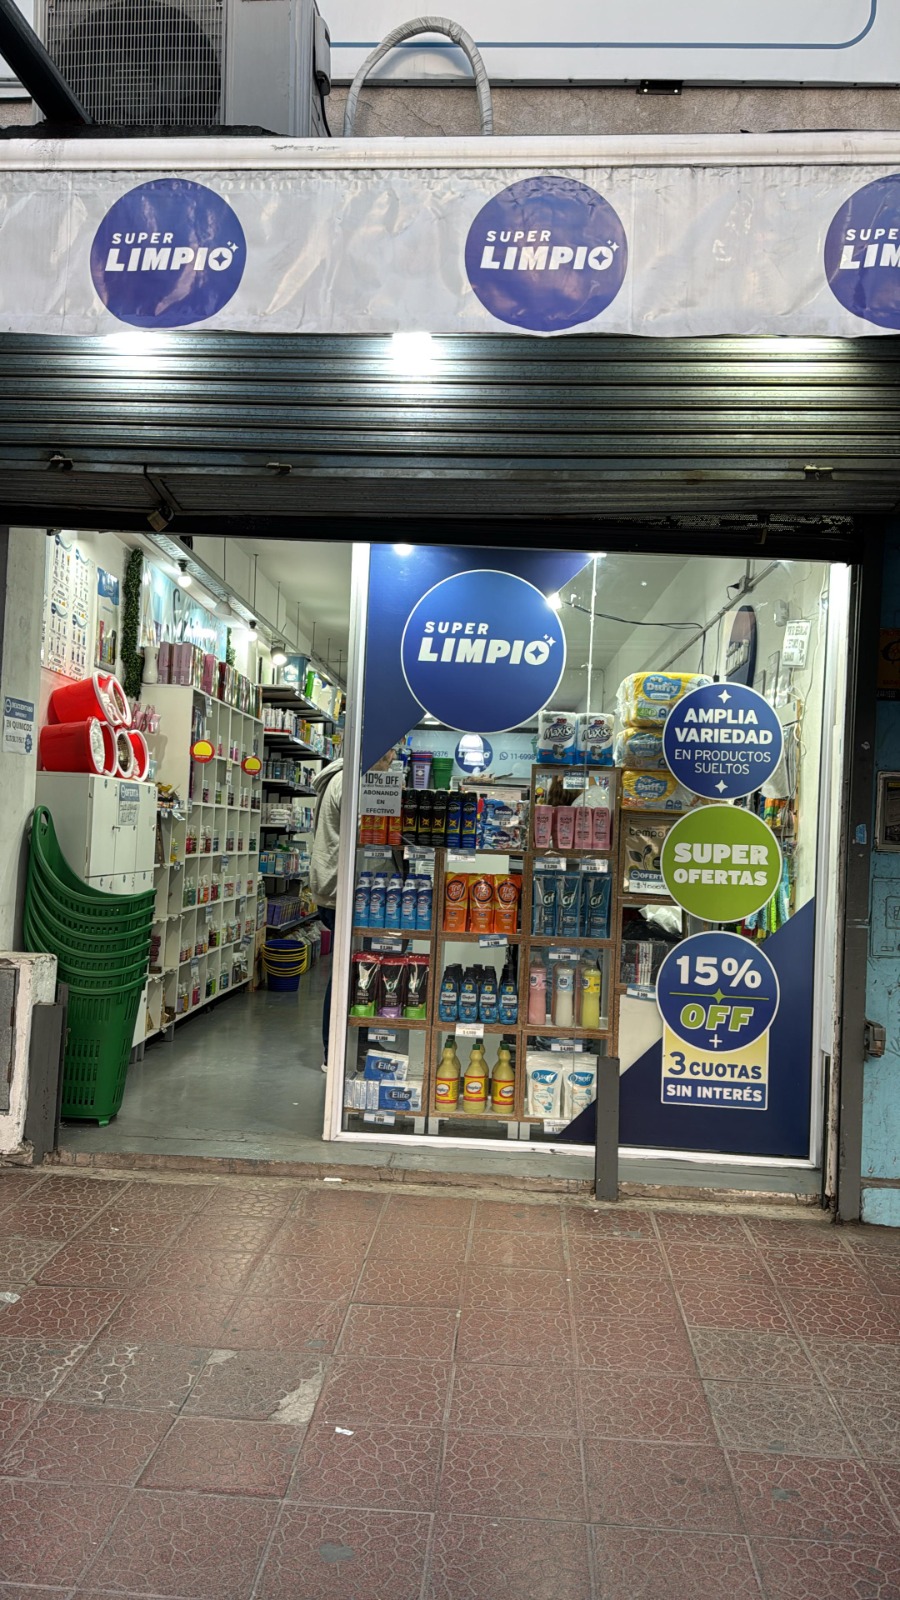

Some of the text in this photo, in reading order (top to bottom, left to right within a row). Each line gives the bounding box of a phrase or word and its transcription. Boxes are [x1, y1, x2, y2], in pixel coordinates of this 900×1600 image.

[112, 232, 174, 244] SUPER
[486, 230, 551, 243] SUPER
[845, 228, 899, 241] SUPE
[105, 247, 233, 272] LIMPIO
[480, 245, 614, 271] LIMPIO
[424, 621, 489, 635] SUPER
[417, 636, 550, 665] LIMPIO
[684, 708, 758, 725] AMPLIA
[674, 727, 773, 745] VARIEDAD
[674, 749, 771, 763] EN PRODUCTOS
[694, 762, 750, 775] SUELTOS
[365, 773, 399, 785] 10% OFF
[629, 826, 664, 838] tempo
[673, 842, 769, 866] SUPER
[673, 868, 768, 886] OFERTAS
[544, 892, 555, 904] Cif
[562, 892, 574, 905] Cif
[590, 893, 602, 905] Cif
[676, 955, 762, 989] 15%
[680, 1002, 754, 1032] OFF
[378, 1061, 396, 1071] Elite
[668, 1051, 762, 1080] 3 CUOTAS
[392, 1090, 410, 1099] Elite
[666, 1084, 763, 1102] SIN INTERÉS
